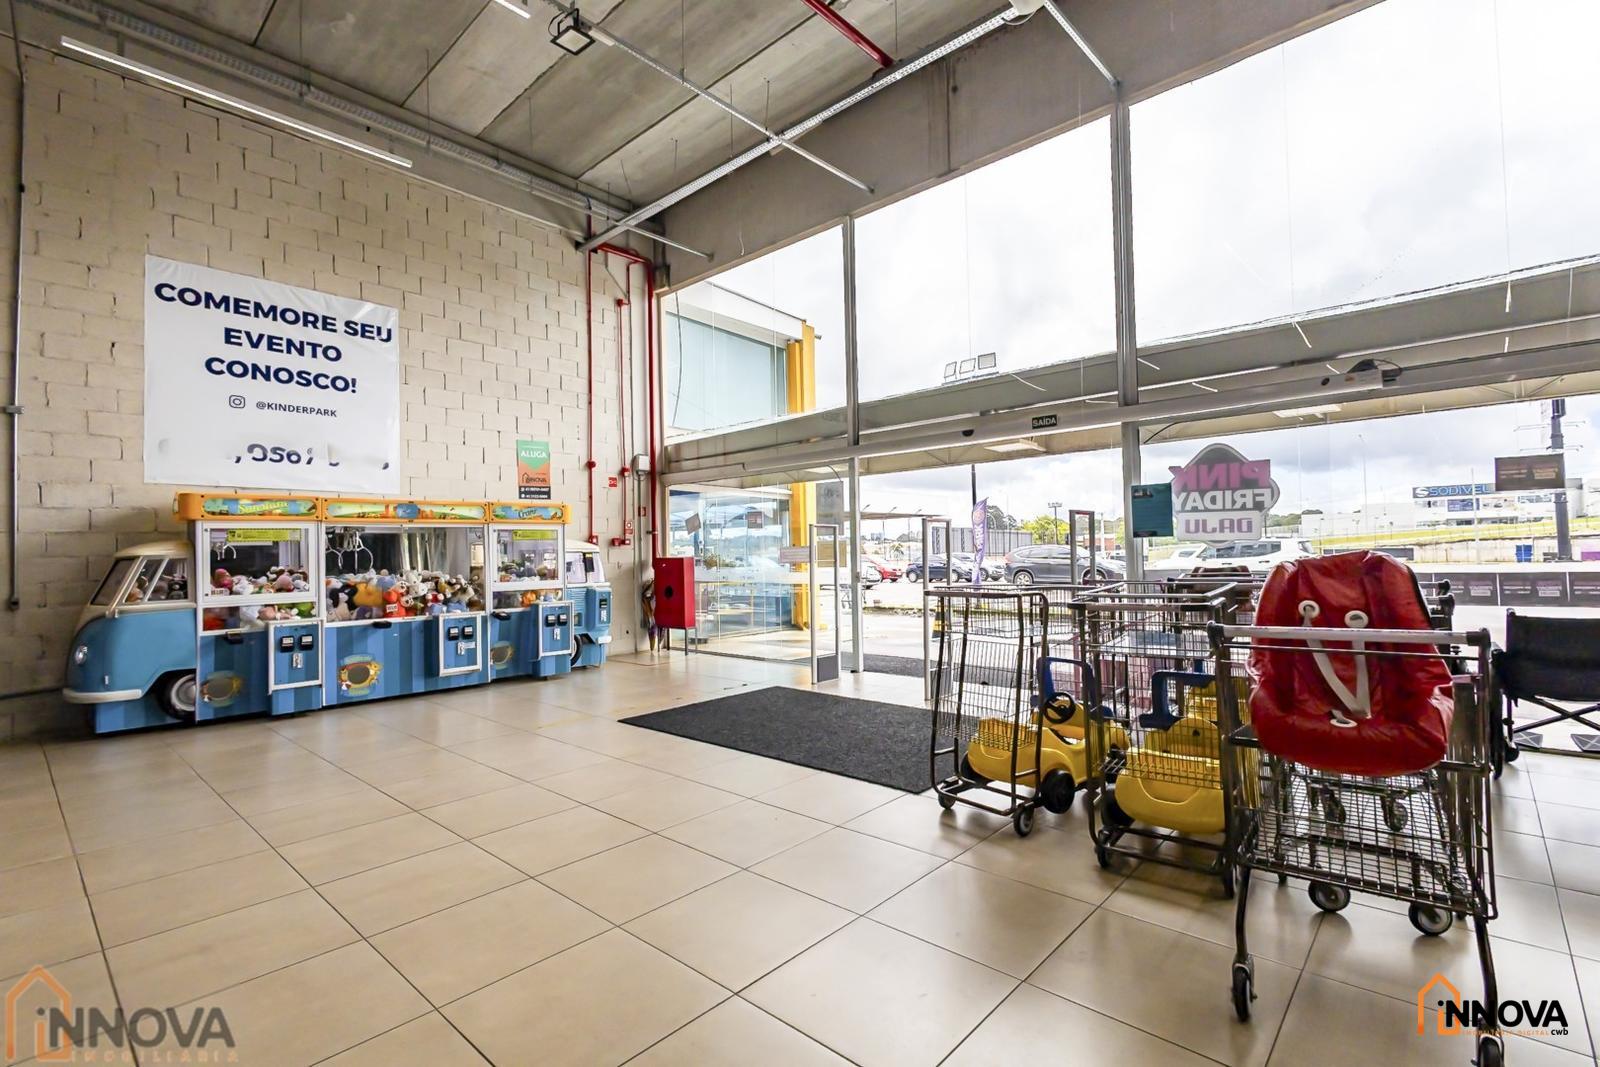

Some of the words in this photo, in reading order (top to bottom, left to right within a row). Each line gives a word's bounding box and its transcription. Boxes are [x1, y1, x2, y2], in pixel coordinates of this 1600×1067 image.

[154, 282, 338, 334] COMEMORE
[343, 319, 392, 343] SEU
[223, 326, 342, 362] EVENTO
[204, 356, 357, 393] CONOSCO!
[256, 401, 337, 418] @KINDERPARK
[1032, 416, 1057, 427] SAÍDA
[520, 450, 548, 458] ALUGA
[1429, 484, 1490, 497] SODIVEL
